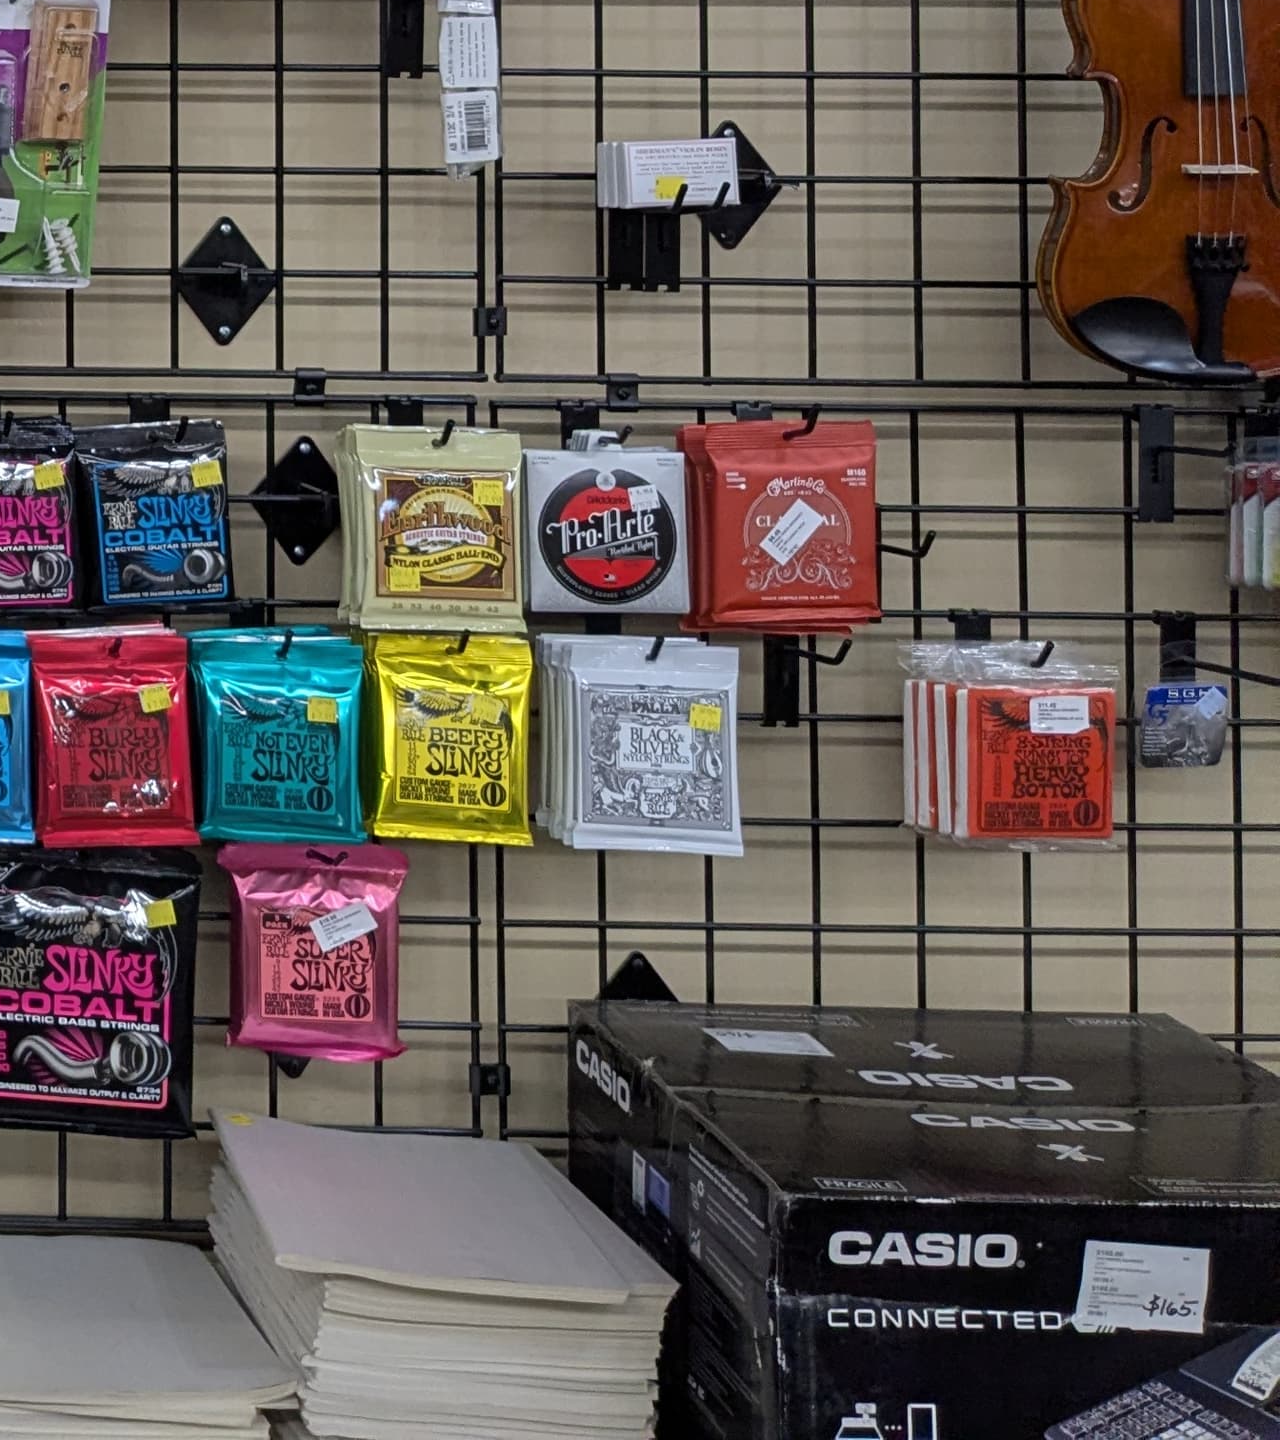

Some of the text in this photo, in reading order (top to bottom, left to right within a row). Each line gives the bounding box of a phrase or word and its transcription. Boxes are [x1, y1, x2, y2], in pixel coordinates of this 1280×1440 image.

[138, 495, 211, 528] SLINKY
[104, 530, 214, 546] COBALT
[255, 733, 329, 754] NOT EVEN
[429, 729, 505, 750] BEEFY
[630, 726, 678, 743] BLACK
[1017, 736, 1092, 749] 8-STRING
[630, 741, 681, 757] SILVER
[251, 752, 331, 784] SLINKY
[425, 744, 506, 779] SLINKY
[1014, 766, 1090, 782] HEAVY
[1013, 783, 1088, 798] BOTTOM
[42, 945, 157, 998] SLINKY
[291, 960, 366, 993] SLINKY
[58, 1018, 96, 1027] BASS
[101, 1021, 159, 1032] STRINGS
[575, 1039, 631, 1113] CASIO
[857, 1069, 1074, 1091] CASIO
[910, 1113, 1136, 1132] CASIO
[828, 1231, 1018, 1268] CASIO
[827, 1309, 1062, 1330] CONNECTED
